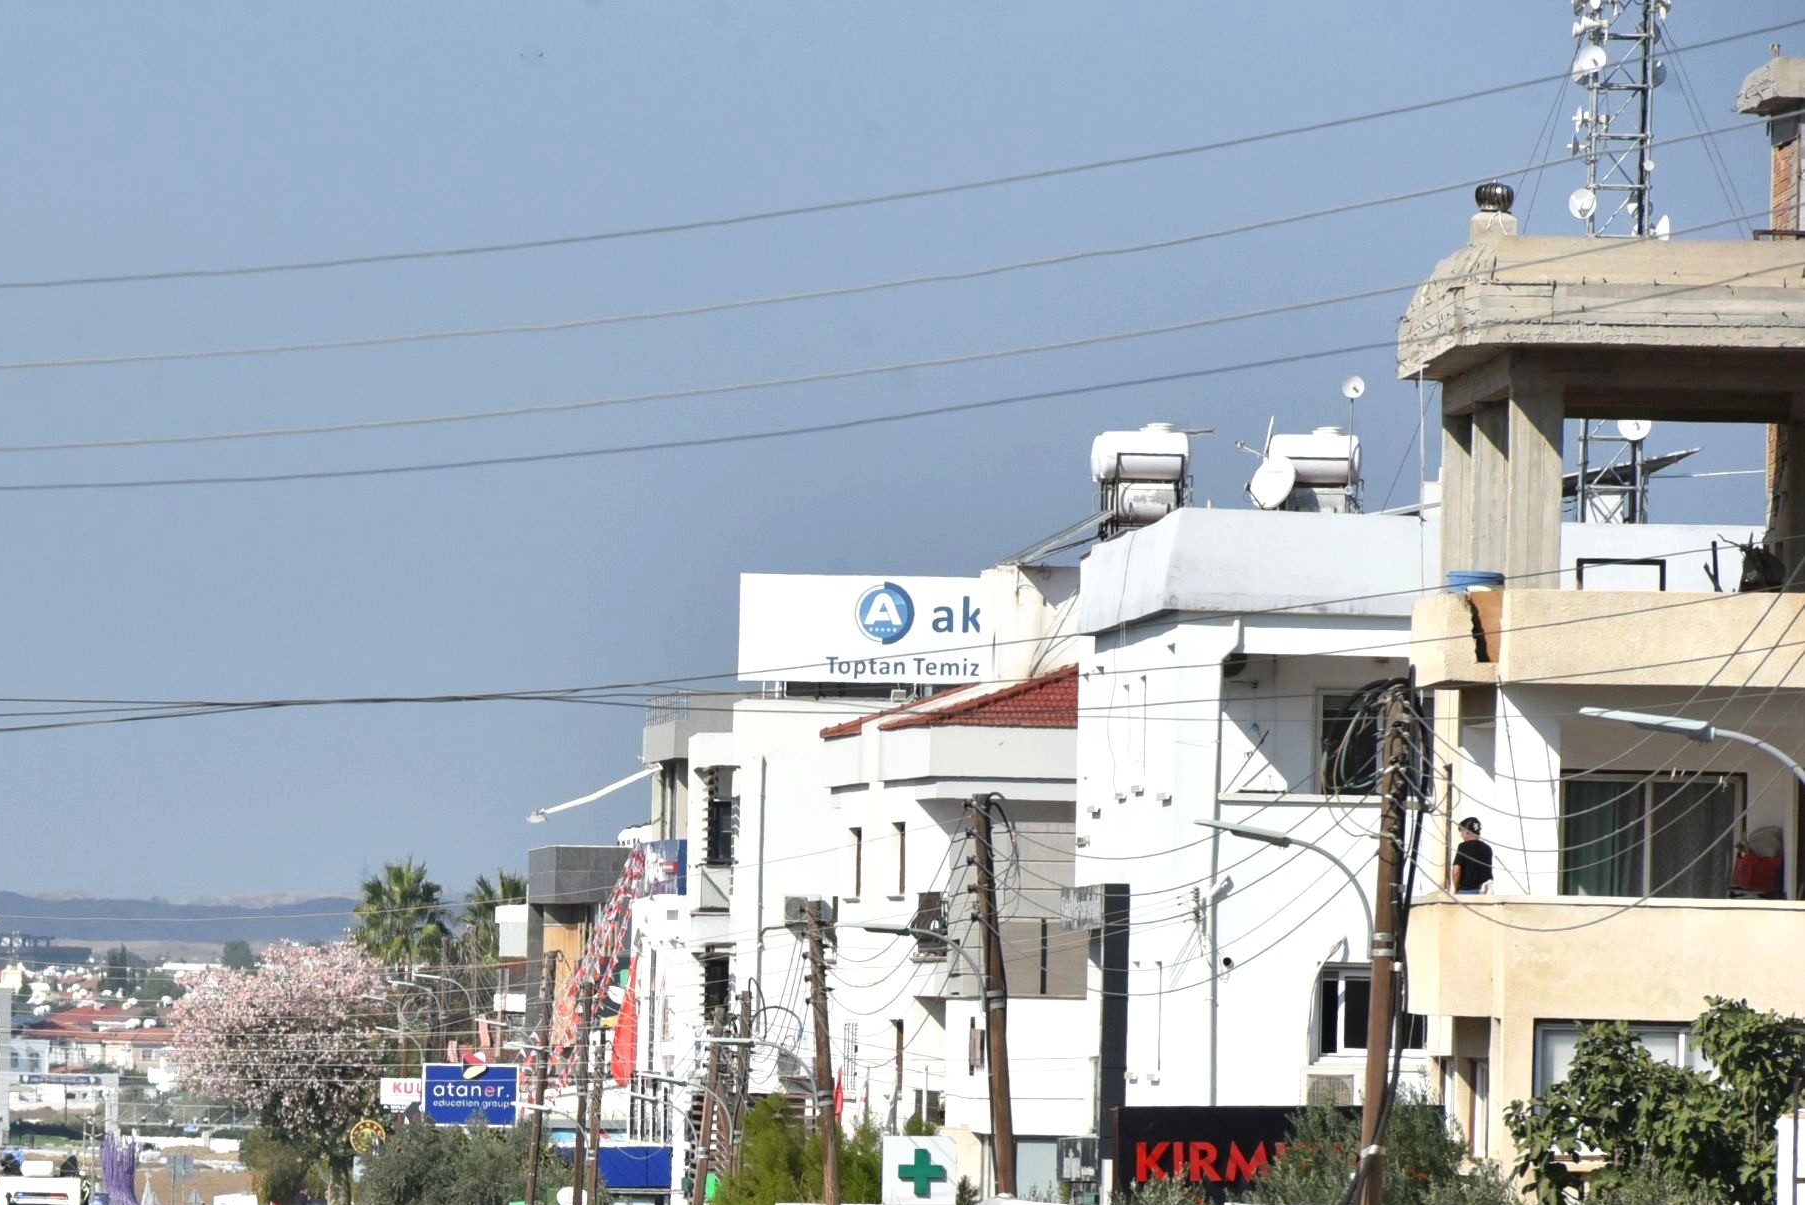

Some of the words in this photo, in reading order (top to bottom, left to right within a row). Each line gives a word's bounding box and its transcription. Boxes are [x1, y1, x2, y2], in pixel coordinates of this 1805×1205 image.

[825, 656, 907, 680] Toptan
[912, 657, 981, 678] Temiz
[432, 1099, 480, 1108] education
[482, 1100, 510, 1109] group
